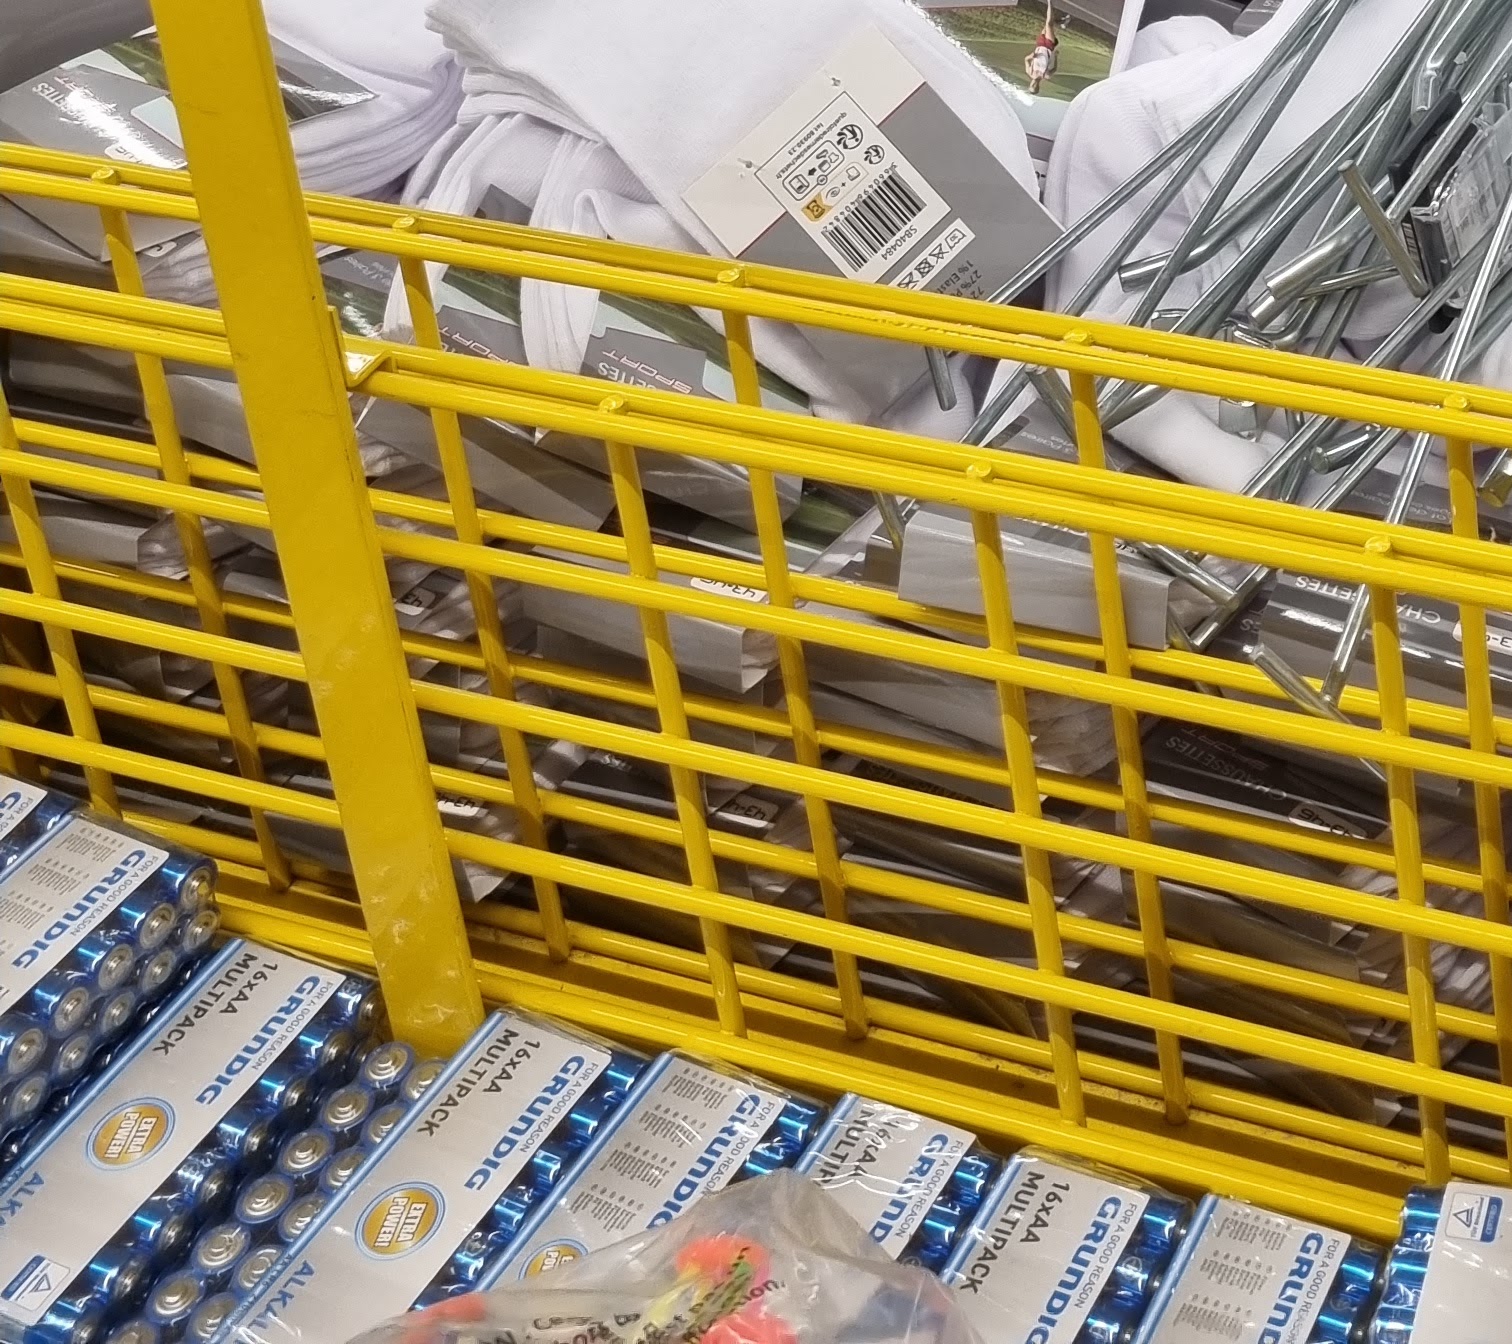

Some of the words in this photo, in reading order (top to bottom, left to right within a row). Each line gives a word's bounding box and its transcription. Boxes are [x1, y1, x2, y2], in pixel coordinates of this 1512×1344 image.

[881, 225, 918, 261] SB40484
[935, 272, 961, 295] Elast
[959, 270, 982, 290] 27%
[960, 260, 974, 276] 1%
[602, 349, 693, 394] SPORT
[11, 849, 147, 970] GRUNDIG
[106, 879, 133, 904] GOOD
[69, 903, 109, 938] REASON
[152, 953, 259, 1056] MULTIPACK
[219, 963, 278, 1014] 16xAA
[315, 981, 334, 1000] FOR
[195, 975, 321, 1105] GRUNDIG
[285, 1008, 310, 1034] GOOD
[251, 1034, 288, 1071] REASON
[481, 1040, 541, 1095] 16xAA
[580, 1061, 600, 1082] FOR
[416, 1027, 519, 1138] MULTIPACK
[553, 1088, 578, 1116] GOOD
[126, 1116, 159, 1155] EXTRA
[463, 1054, 586, 1191] GRUNDIG
[519, 1115, 555, 1154] REASON
[868, 1133, 950, 1245] GRUND
[373, 1195, 410, 1249] POWER!
[396, 1200, 429, 1244] EXTRA
[896, 1194, 926, 1240] REASON
[958, 1170, 1046, 1295] MULTIPACK
[1018, 1182, 1071, 1245] 16xAA
[1120, 1202, 1138, 1225] FOR
[1099, 1233, 1121, 1265] GOOD
[1325, 1238, 1341, 1261] FOR
[1073, 1264, 1104, 1310] REASON
[1309, 1270, 1327, 1300] GOOD
